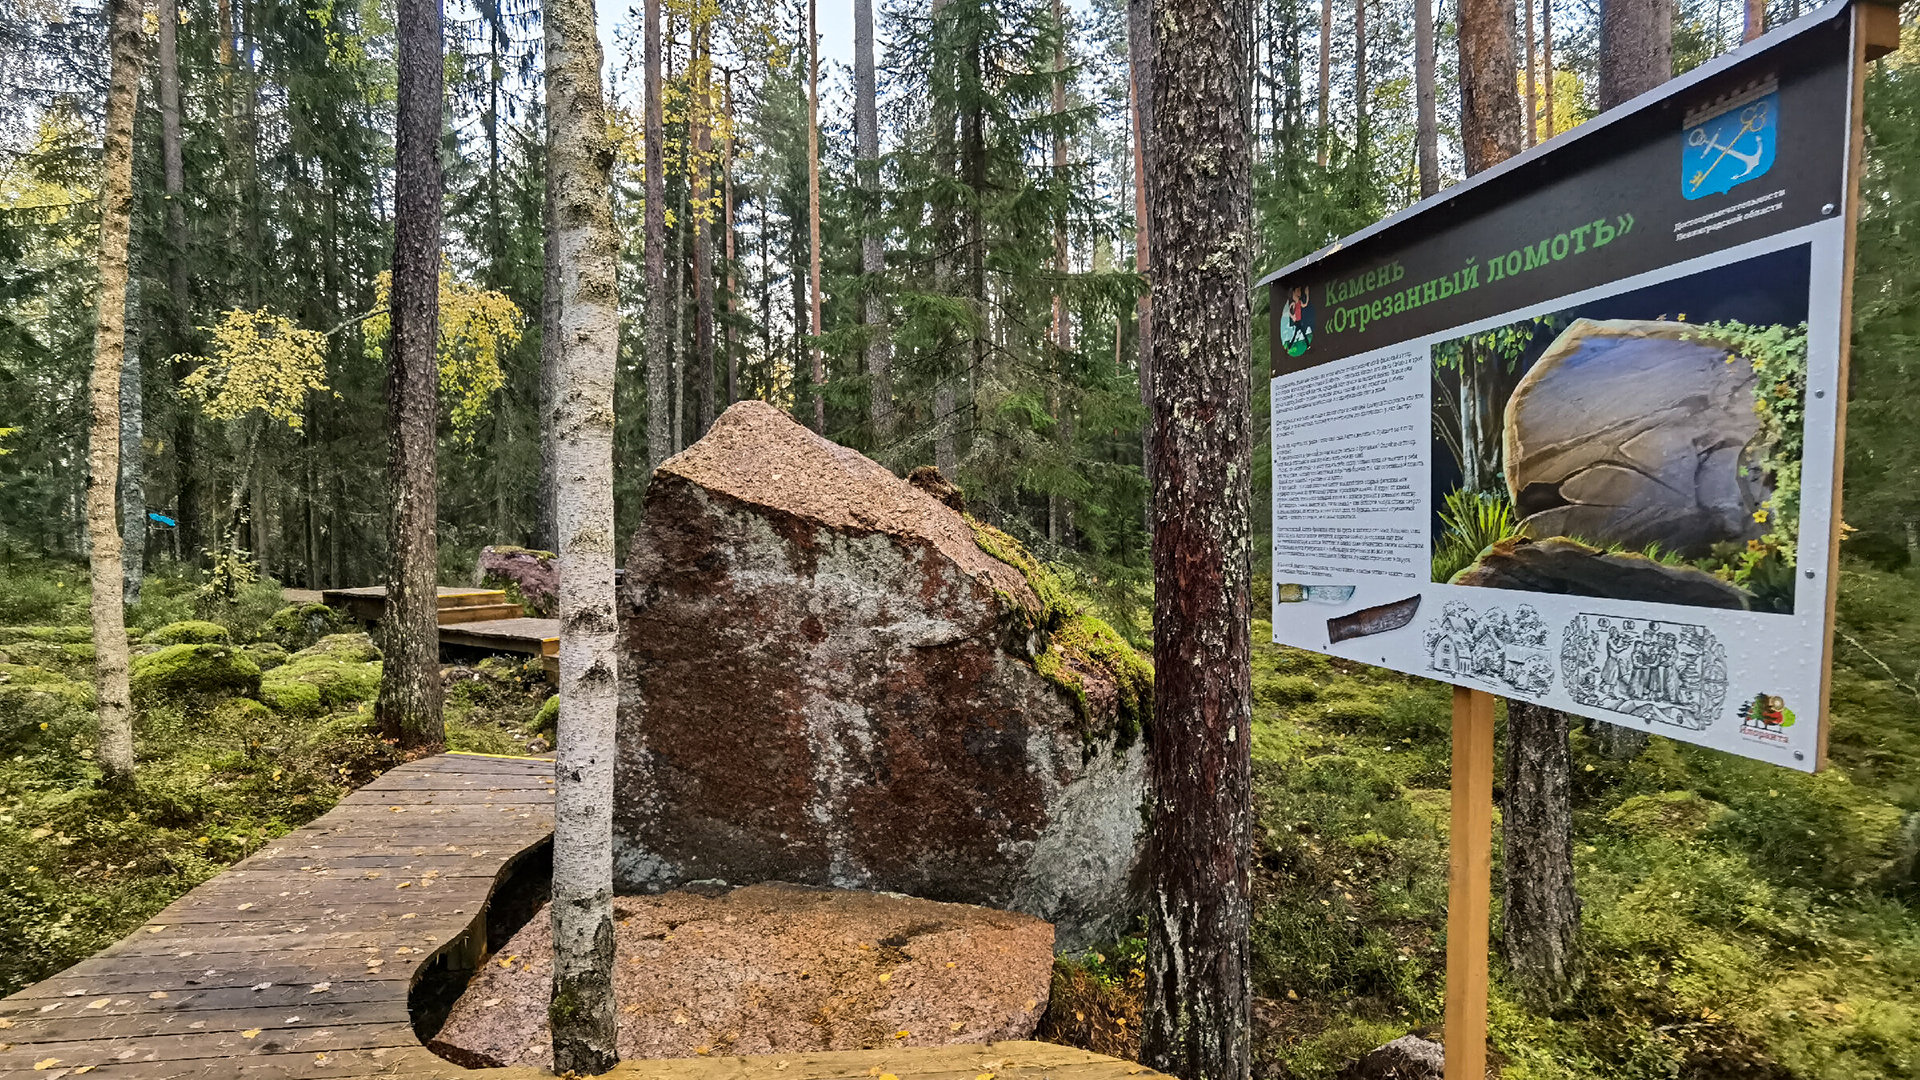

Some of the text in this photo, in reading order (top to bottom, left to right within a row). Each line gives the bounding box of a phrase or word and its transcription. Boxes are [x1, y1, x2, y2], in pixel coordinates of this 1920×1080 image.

[1324, 212, 1635, 334] «Отрезанный ломоть»
[1324, 260, 1405, 307] Камень
